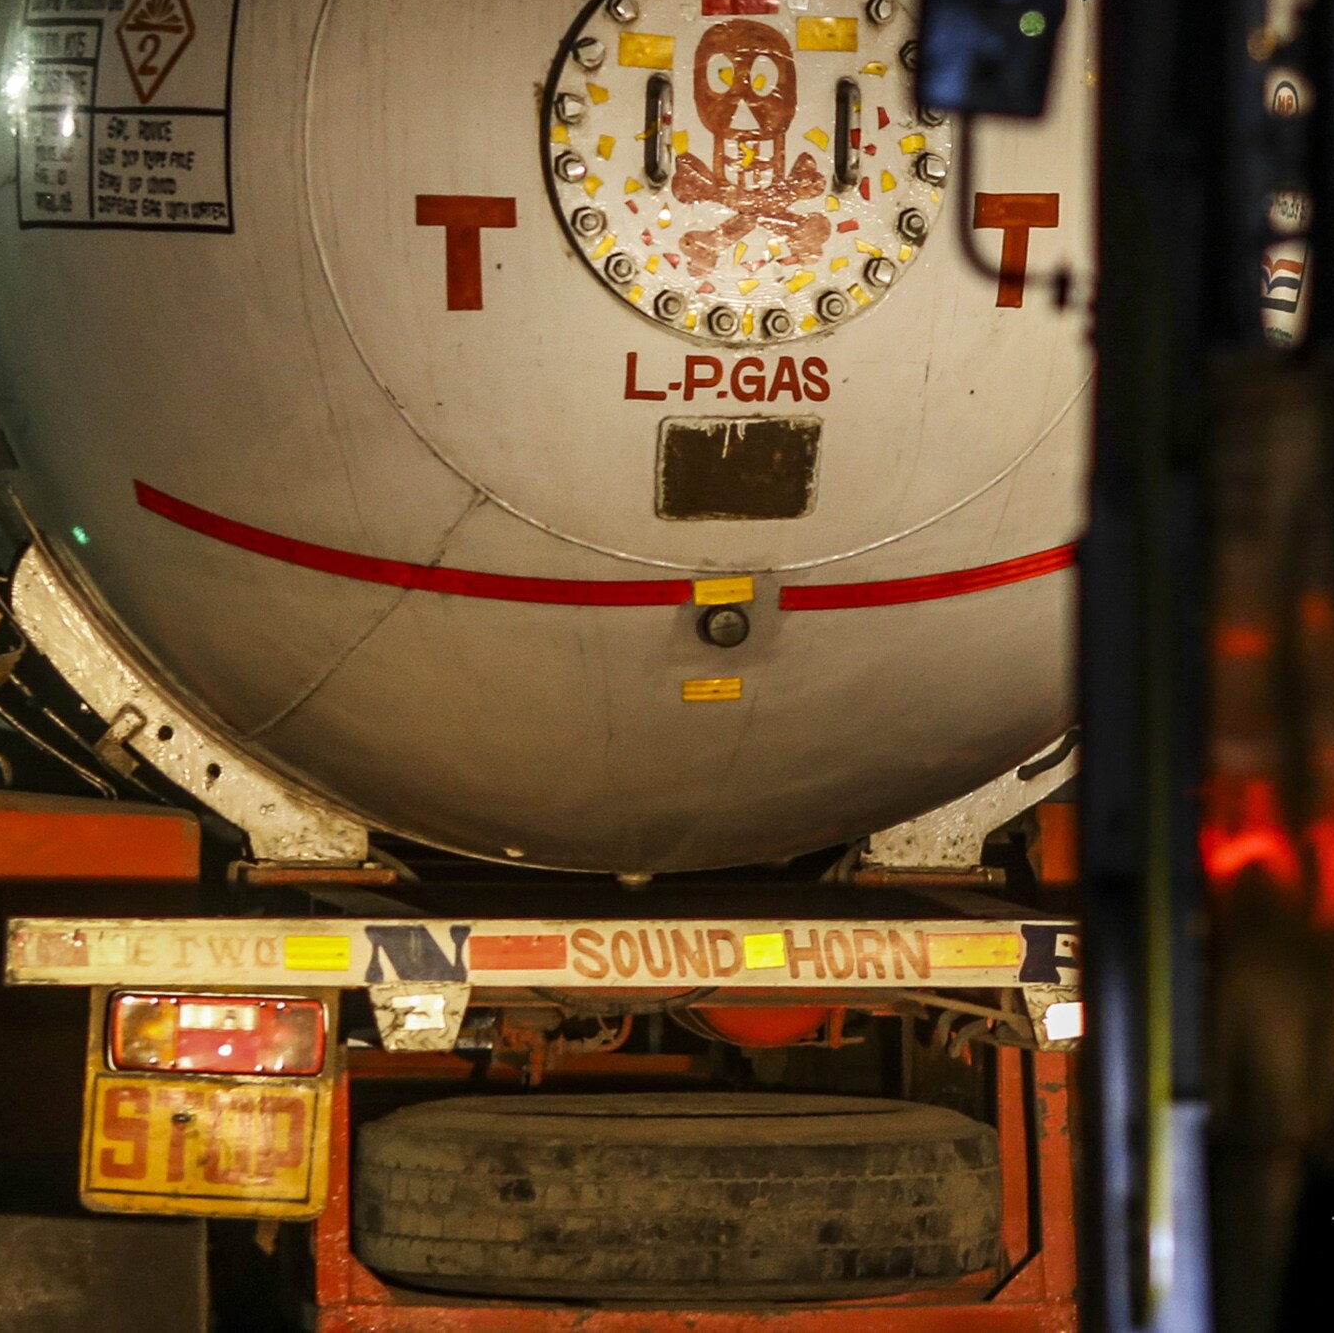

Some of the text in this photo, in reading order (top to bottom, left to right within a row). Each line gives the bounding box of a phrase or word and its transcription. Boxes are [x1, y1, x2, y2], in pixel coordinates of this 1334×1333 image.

[136, 33, 162, 76] 2
[415, 194, 517, 311] T
[973, 192, 1060, 308] T
[364, 924, 472, 983] N
[569, 927, 931, 980] SOUND HORN
[98, 1085, 308, 1186] STOP
